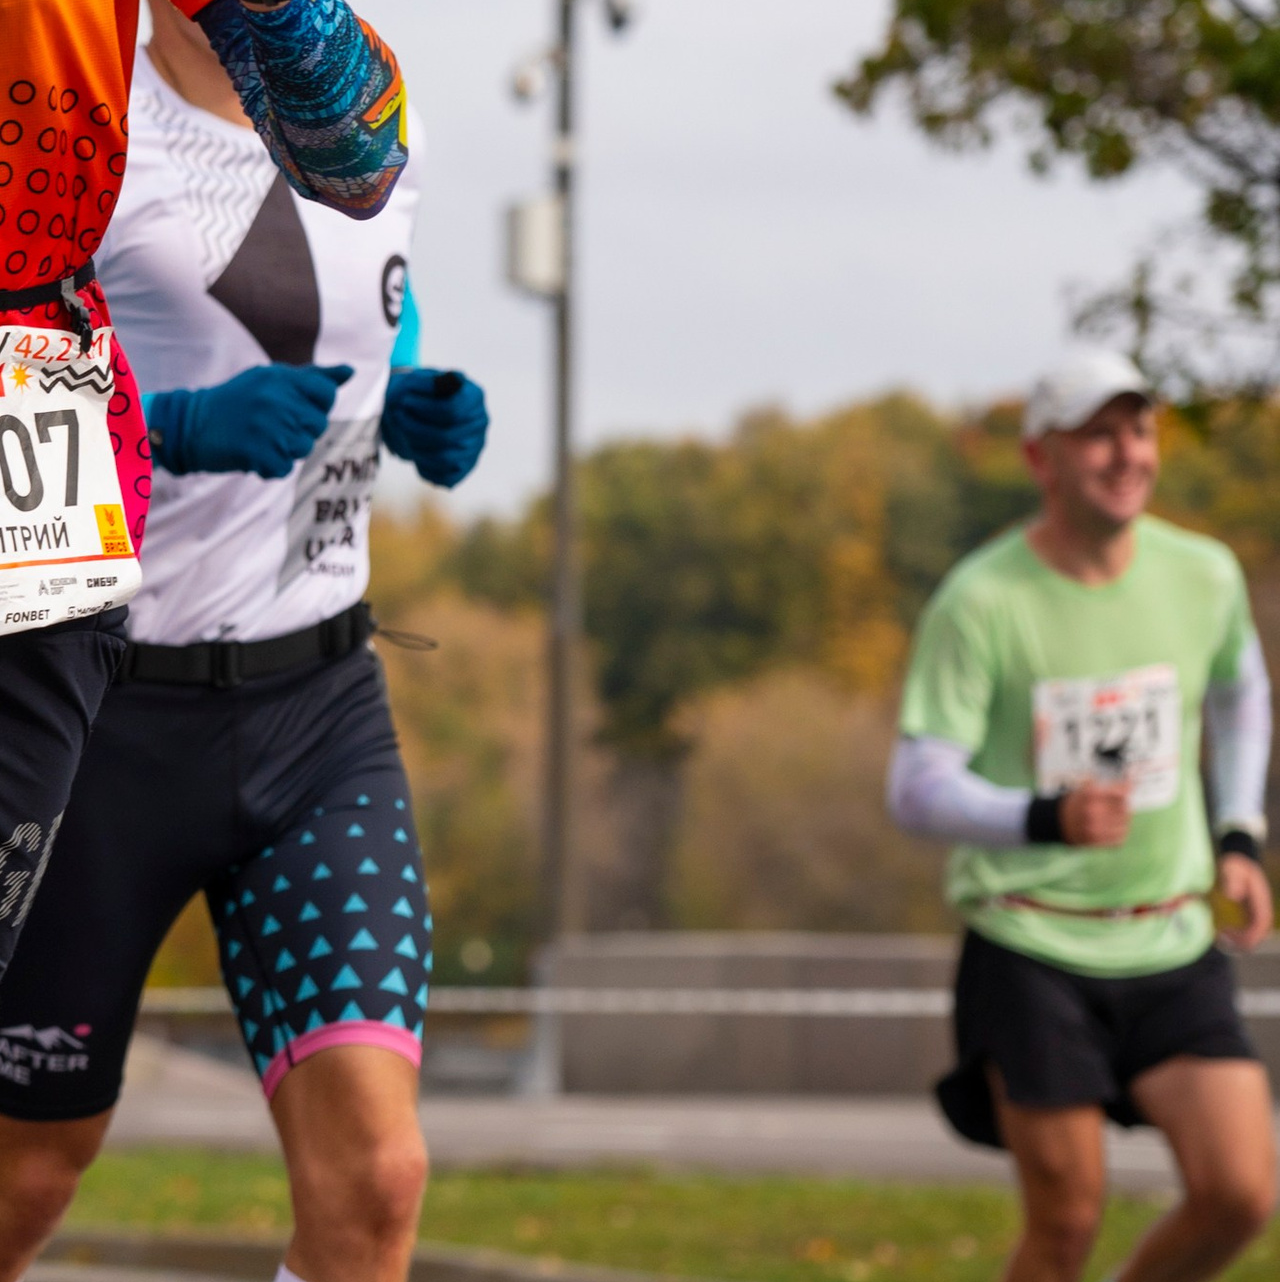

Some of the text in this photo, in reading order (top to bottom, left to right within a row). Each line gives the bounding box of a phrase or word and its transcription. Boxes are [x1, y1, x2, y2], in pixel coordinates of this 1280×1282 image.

[14, 333, 73, 364] 42,2
[86, 576, 118, 588] СИБУР
[4, 609, 50, 624] FONBET
